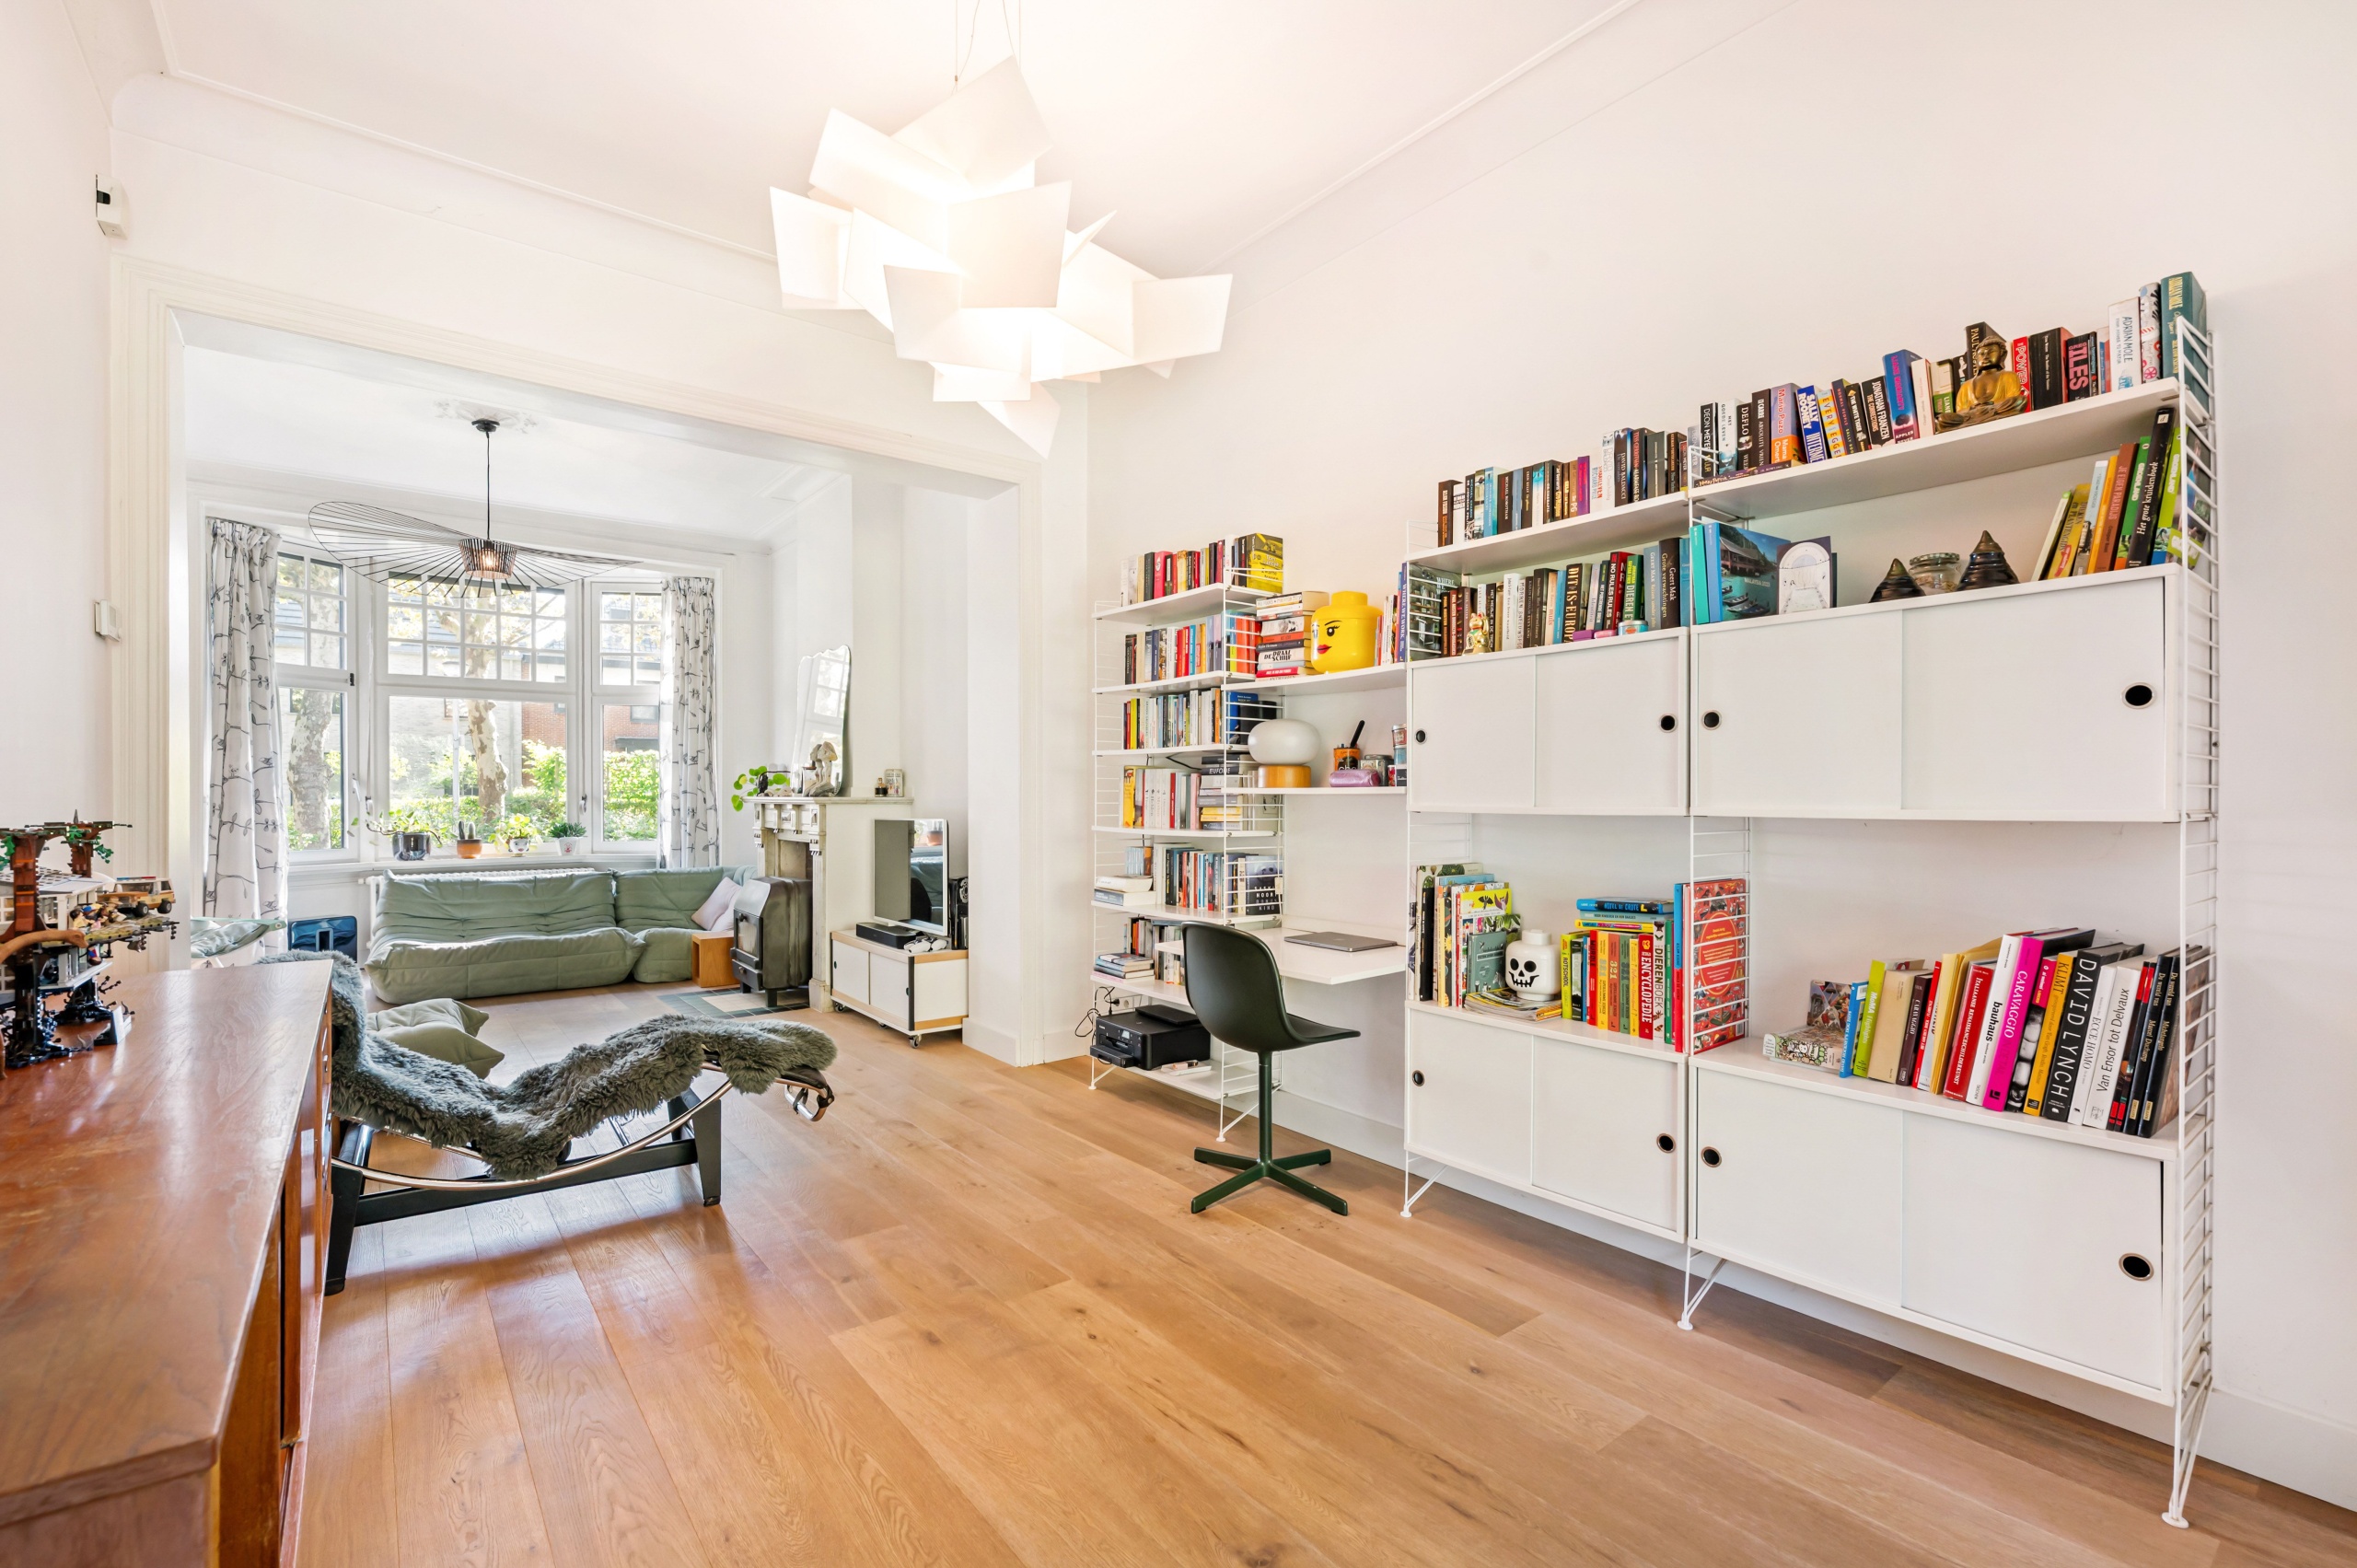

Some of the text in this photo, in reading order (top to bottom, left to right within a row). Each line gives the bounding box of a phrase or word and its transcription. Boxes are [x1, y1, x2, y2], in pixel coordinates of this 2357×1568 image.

[1970, 327, 1980, 350] PAUL
[2122, 316, 2133, 364] ADRIAN MOLE
[2014, 345, 2028, 385] POWER
[2068, 346, 2089, 390] ILES
[1890, 355, 1905, 411] LIANE MORIARTY
[1741, 406, 1749, 436] DEFLO
[1806, 394, 1818, 423] SALLY
[1822, 397, 1834, 426] EVERY
[1872, 380, 1890, 440] JONATHAN FRANZEN
[1798, 393, 1828, 464] ROONEY INTERME
[1896, 431, 1913, 439] APPLES
[2114, 473, 2125, 492] EIGEN
[2137, 461, 2158, 535] Het grote kruidenboek
[1568, 566, 1579, 586] DIT
[1610, 563, 1616, 574] NO
[1744, 577, 1761, 586] MALAYSIA
[1625, 585, 1635, 612] DIEREN
[1609, 960, 1618, 980] 321
[1621, 961, 1630, 981] 321
[1654, 947, 1664, 1009] DIERENBOEK
[2052, 961, 2070, 994] KLIMT
[2159, 972, 2165, 981] De
[2171, 972, 2177, 981] De
[1641, 957, 1653, 1024] ENCYCLOPEDIE
[1867, 991, 1877, 1014] MoMA
[1970, 977, 1983, 1008] ITALIAANSE
[2003, 970, 2028, 1039] CARAVAGGIO
[2067, 958, 2097, 1026] DAVID
[2154, 981, 2164, 998] wereld
[2167, 981, 2177, 998] wereld
[1910, 999, 1920, 1035] CARAVAGGIO
[1986, 1002, 2003, 1042] bauhaus
[2145, 1019, 2156, 1040] Marcel
[2083, 1016, 2102, 1070] ECCE HOMO
[2096, 988, 2130, 1093] Van Ensor tot Delvaux
[2050, 1031, 2081, 1098] LYNCH
